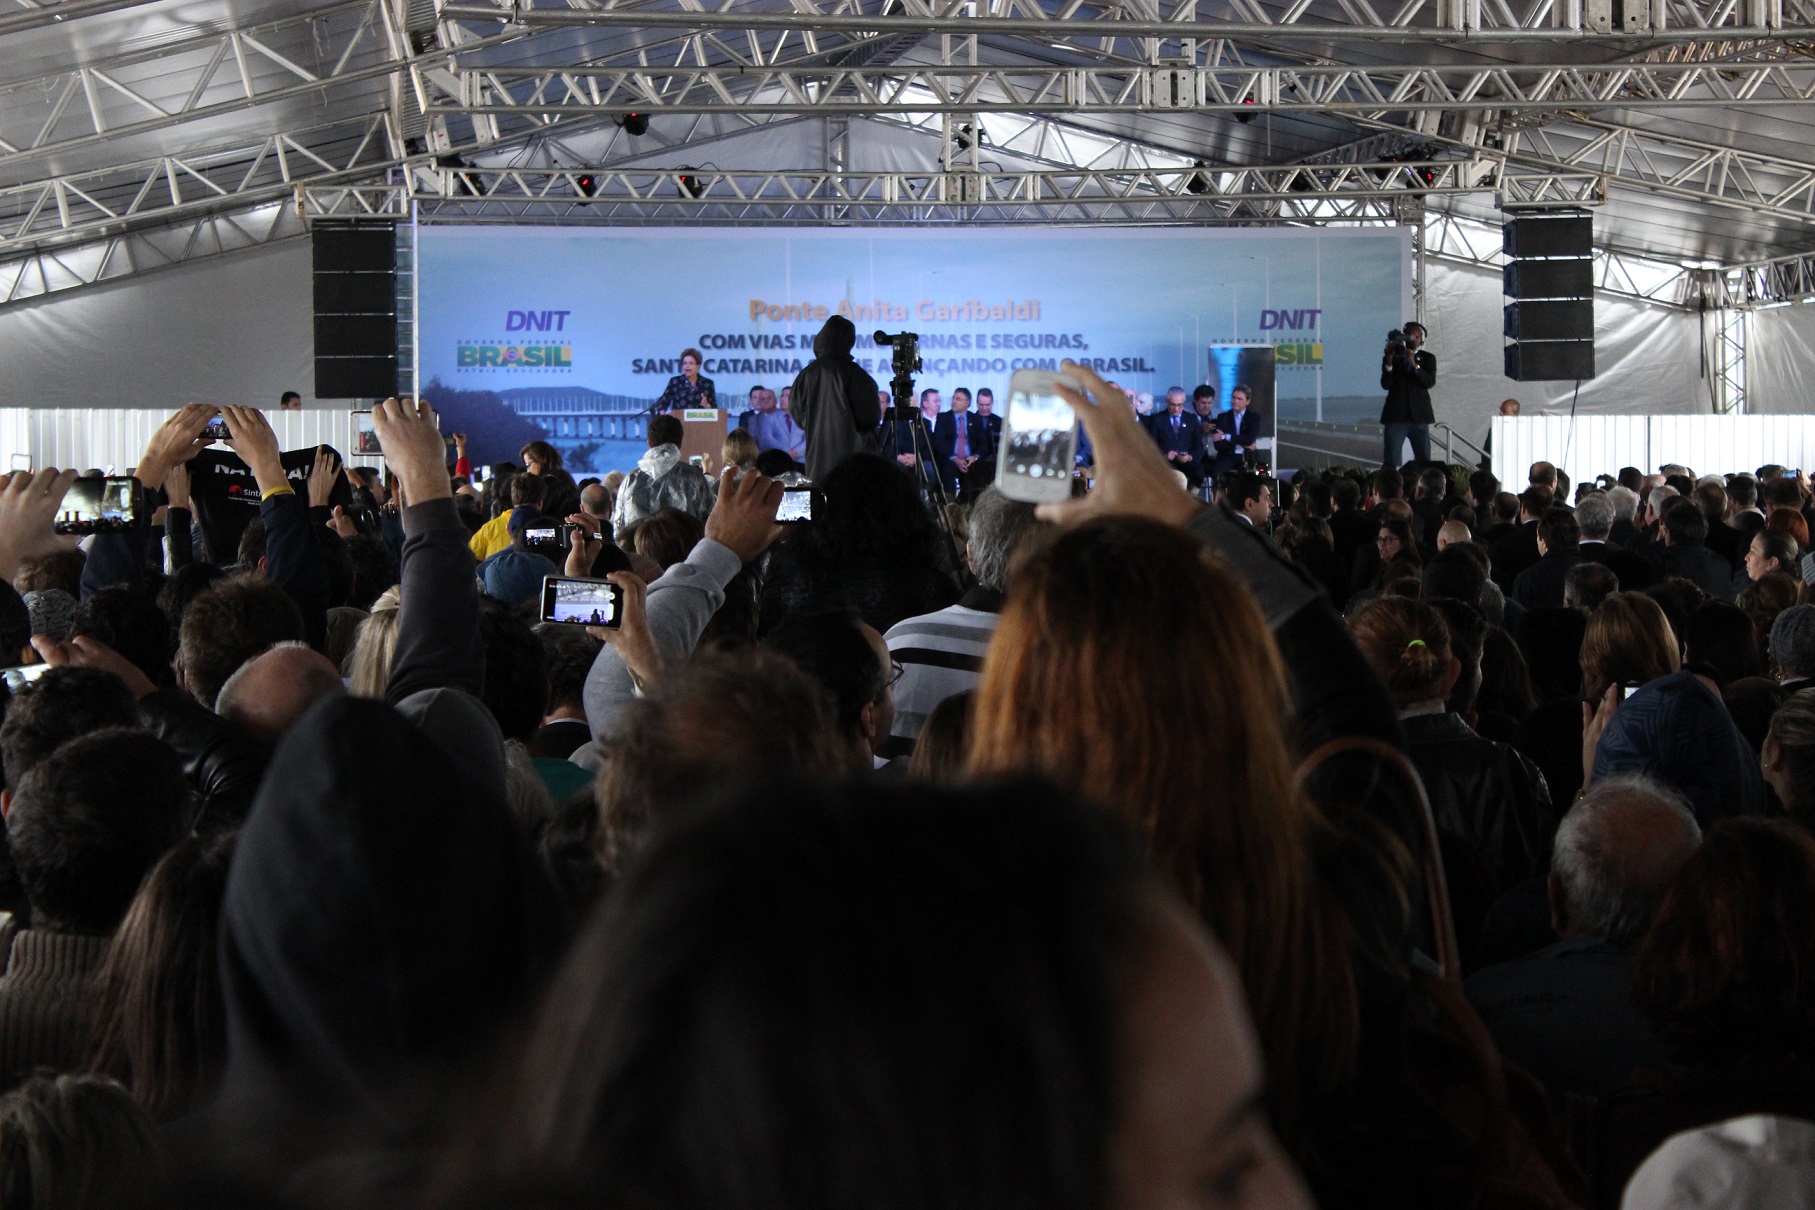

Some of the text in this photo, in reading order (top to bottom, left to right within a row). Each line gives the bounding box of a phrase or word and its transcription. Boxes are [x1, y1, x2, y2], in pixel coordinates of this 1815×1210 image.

[749, 298, 1041, 321] Ponte Anita Garibaldi
[1259, 309, 1322, 330] DNIT
[505, 310, 571, 332] DNIT
[699, 334, 745, 351] COM
[749, 334, 796, 351] VIAS
[855, 334, 972, 350] MRNAS
[975, 334, 987, 349] E
[991, 333, 1089, 352] SEGURAS,
[457, 345, 572, 367] BRASIL
[632, 358, 688, 375] SANT
[703, 357, 803, 375] CATARINA
[876, 357, 1007, 378] ANÇANDO
[1010, 357, 1056, 372] COM
